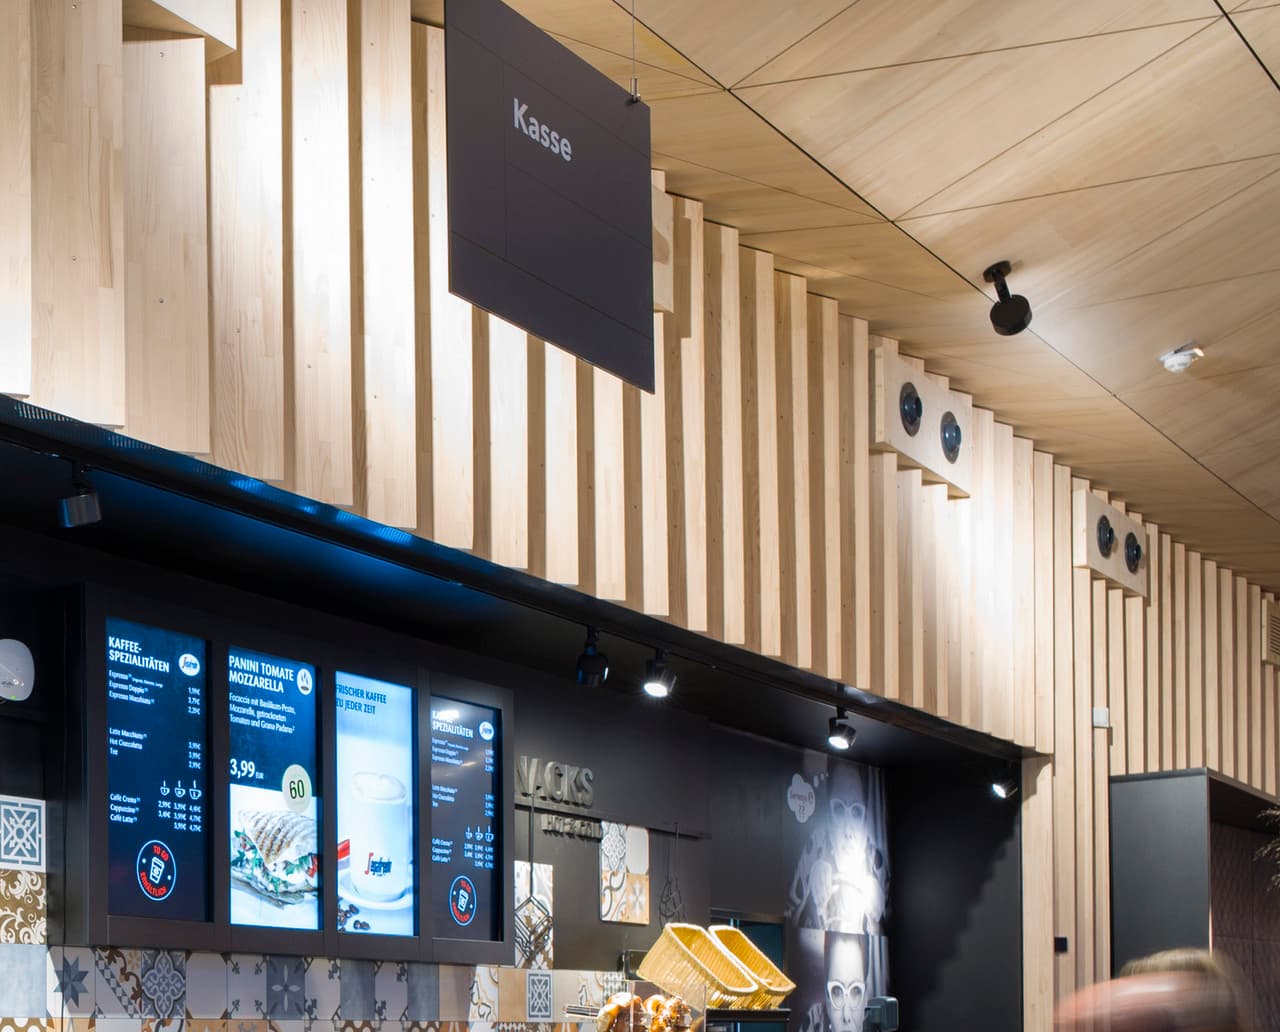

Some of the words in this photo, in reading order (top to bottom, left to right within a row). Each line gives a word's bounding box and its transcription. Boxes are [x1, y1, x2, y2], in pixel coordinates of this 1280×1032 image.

[513, 97, 572, 161] Kasse
[108, 636, 142, 653] KAFFEE-
[108, 649, 170, 673] SPEZIALITÄTEN
[229, 655, 259, 673] PANINI
[261, 662, 295, 682] TOMATE
[229, 670, 285, 694] MOZZARELLA
[344, 700, 363, 712] JEDER
[363, 703, 376, 715] ZEIT
[365, 690, 387, 705] KAFFEE
[230, 758, 256, 779] 3,99
[289, 779, 305, 800] 60
[515, 755, 593, 807] NACKS
